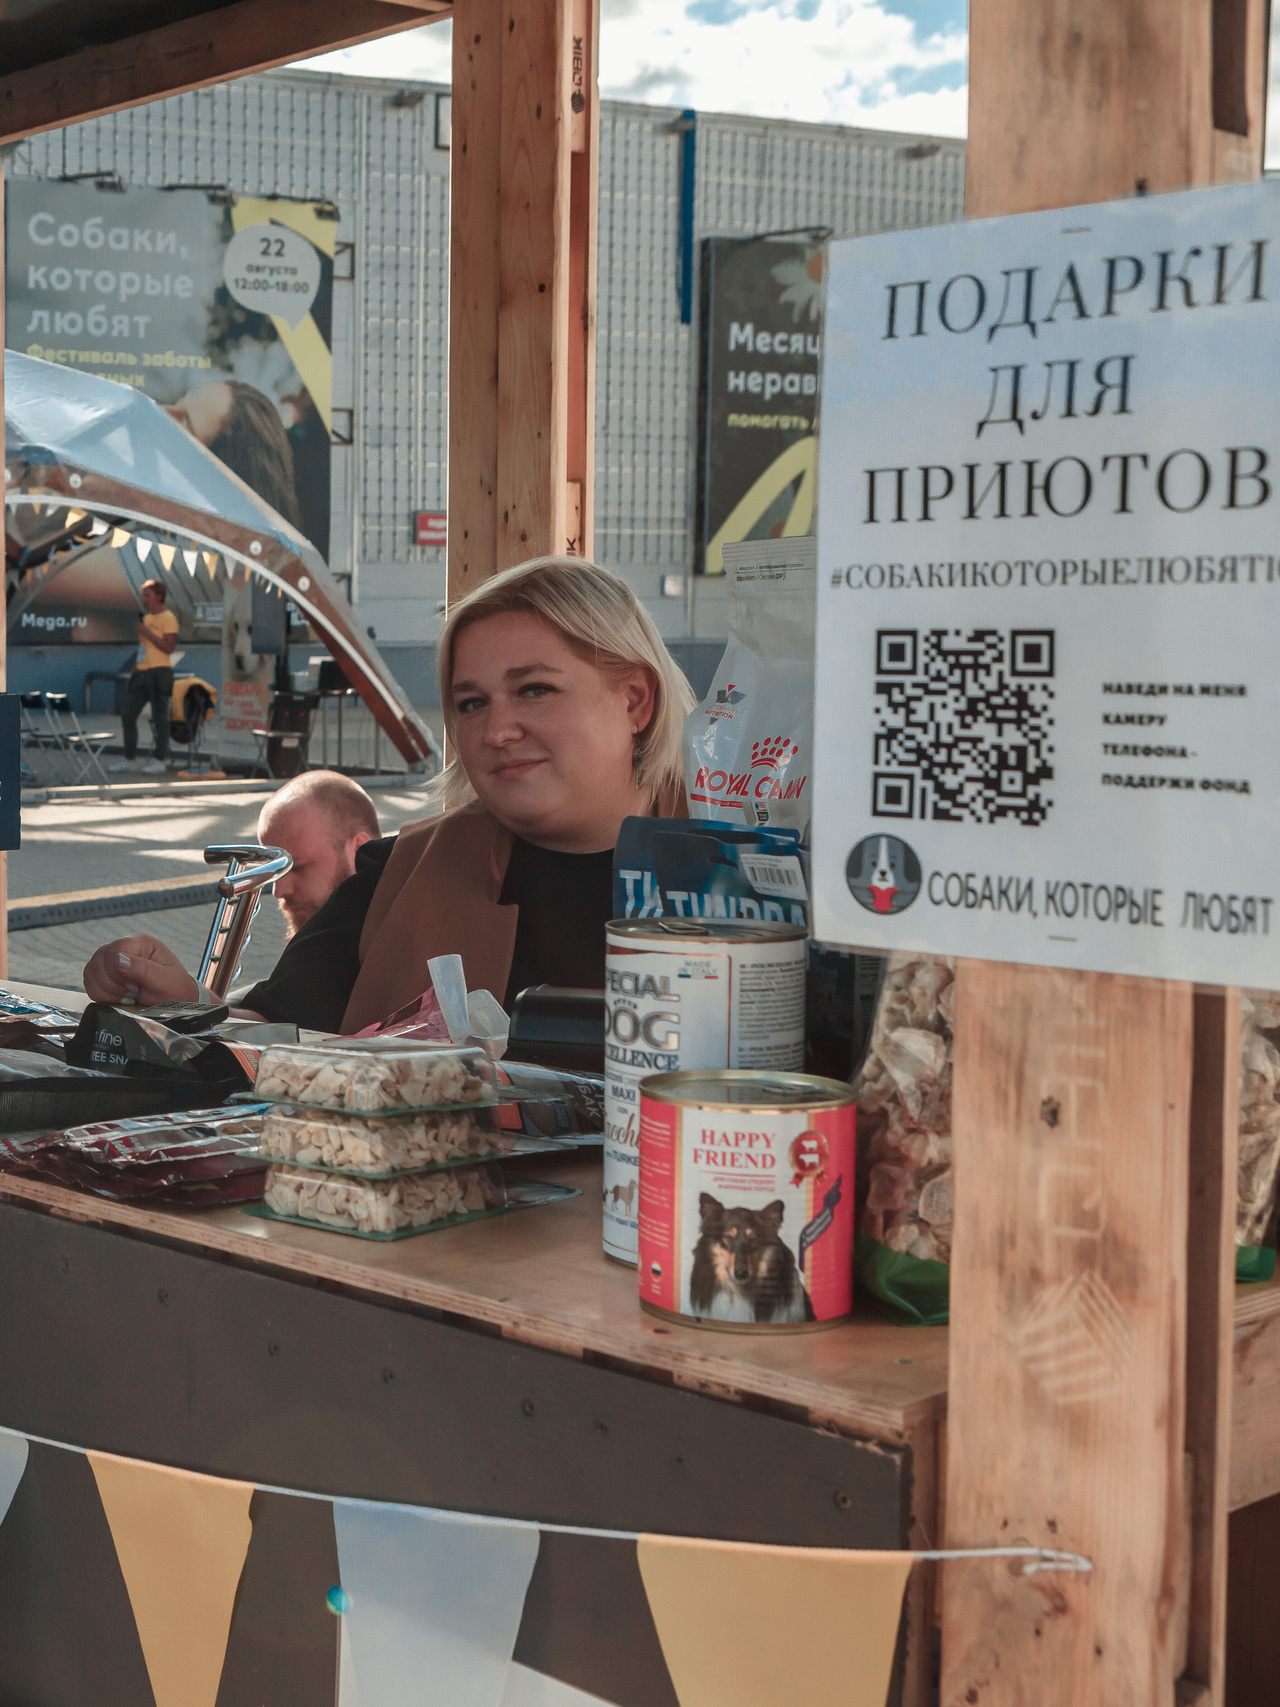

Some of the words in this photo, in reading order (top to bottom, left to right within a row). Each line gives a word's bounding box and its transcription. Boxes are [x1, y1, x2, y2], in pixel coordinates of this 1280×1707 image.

[27, 211, 189, 260] Собаки,
[260, 236, 285, 258] 22
[246, 263, 298, 277] августа
[26, 264, 194, 302] которые
[234, 277, 310, 294] 12:00-18:00
[882, 238, 1270, 342] ПОДАРКИ
[26, 303, 151, 339] любят
[727, 321, 820, 357] Месяц
[26, 343, 138, 365] Фестиваль
[142, 350, 212, 369] заботы
[726, 369, 819, 401] нерав
[976, 353, 1137, 439] ДЛЯ
[727, 413, 810, 430] помогать
[862, 446, 1271, 524] ПРИЮТОВ
[21, 612, 88, 631] Mega.ru
[1102, 681, 1168, 696] НАВЕДИ
[1172, 682, 1194, 696] НА
[1199, 683, 1247, 698] МЕНЯ
[1102, 712, 1167, 726] КАМЕРУ
[1102, 742, 1189, 758] ТЕЛЕФОНА
[695, 765, 753, 797] ROYAL
[1102, 772, 1195, 789] ПОДДЕРЖИ
[1199, 779, 1251, 794] ФОНД
[928, 869, 1038, 919] СОБАКИ,
[1044, 880, 1165, 927] КОТОРЫЕ
[1179, 891, 1273, 935] ЛЮБЯТ
[611, 1084, 636, 1102] MAXI
[701, 1128, 776, 1149] HAPPY
[611, 1150, 640, 1168] TURKE
[693, 1148, 776, 1170] FRIEND
